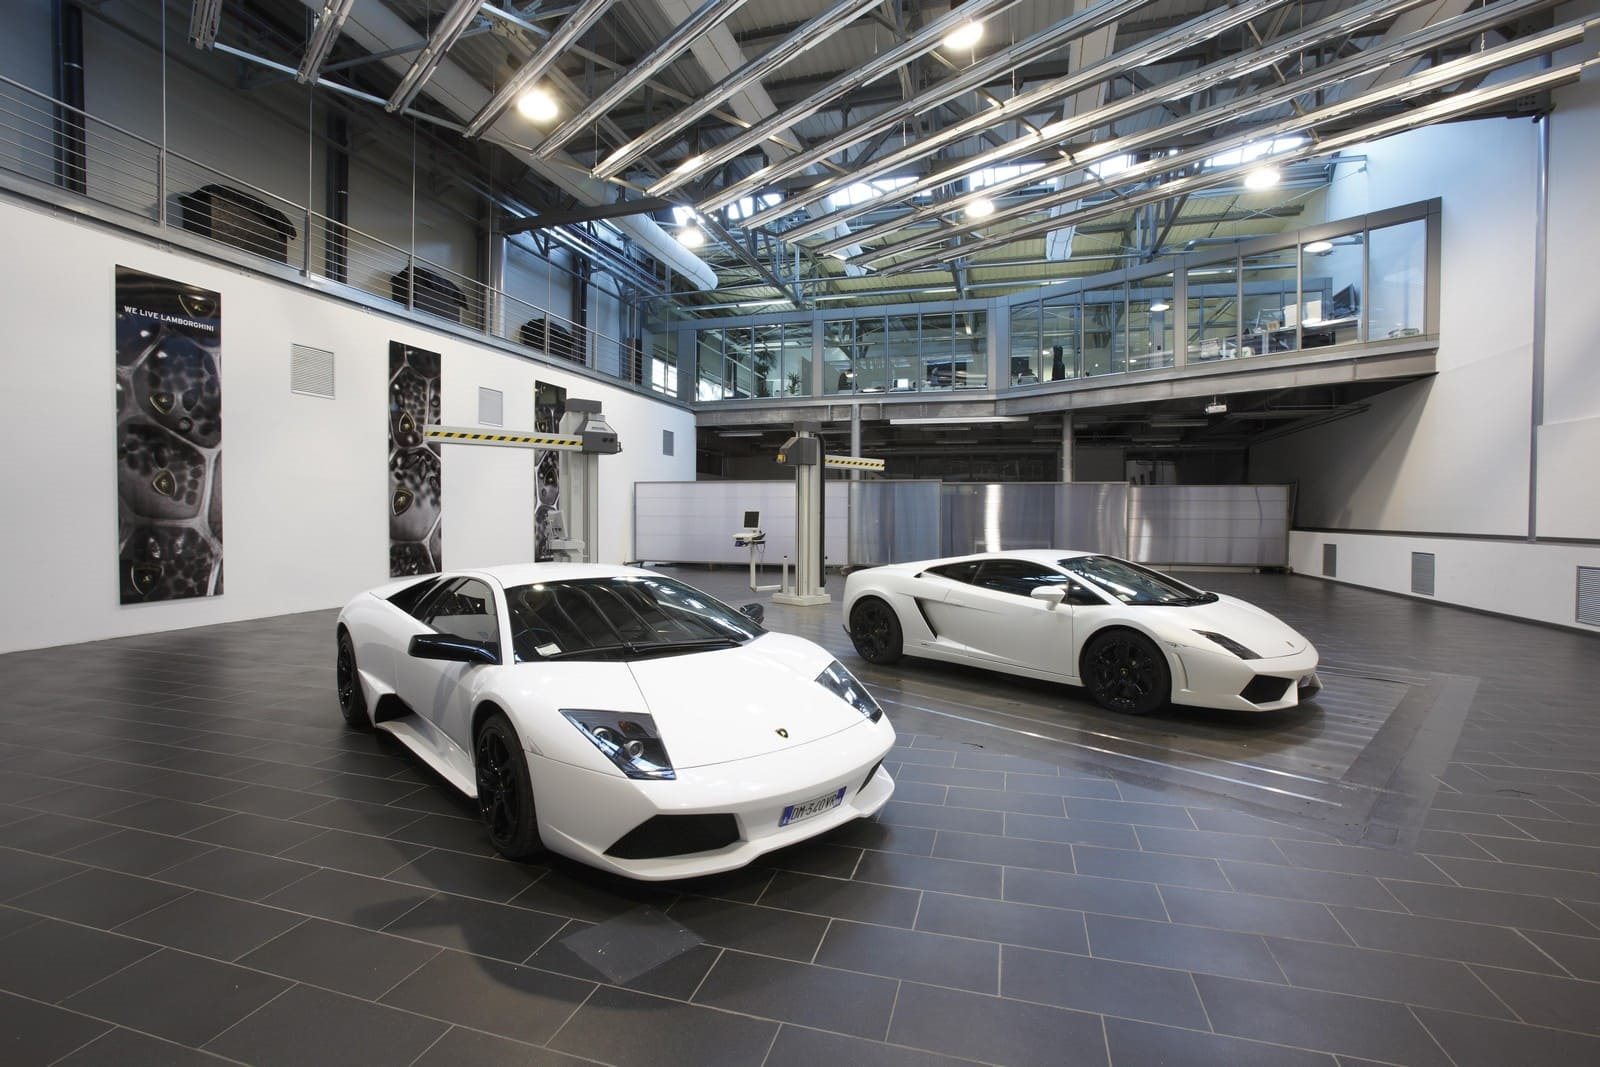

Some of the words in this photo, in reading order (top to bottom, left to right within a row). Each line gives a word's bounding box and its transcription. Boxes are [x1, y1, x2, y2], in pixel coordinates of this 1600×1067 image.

[123, 305, 138, 315] WE
[140, 309, 159, 319] LIVE
[160, 314, 214, 332] LAMBORGHINI
